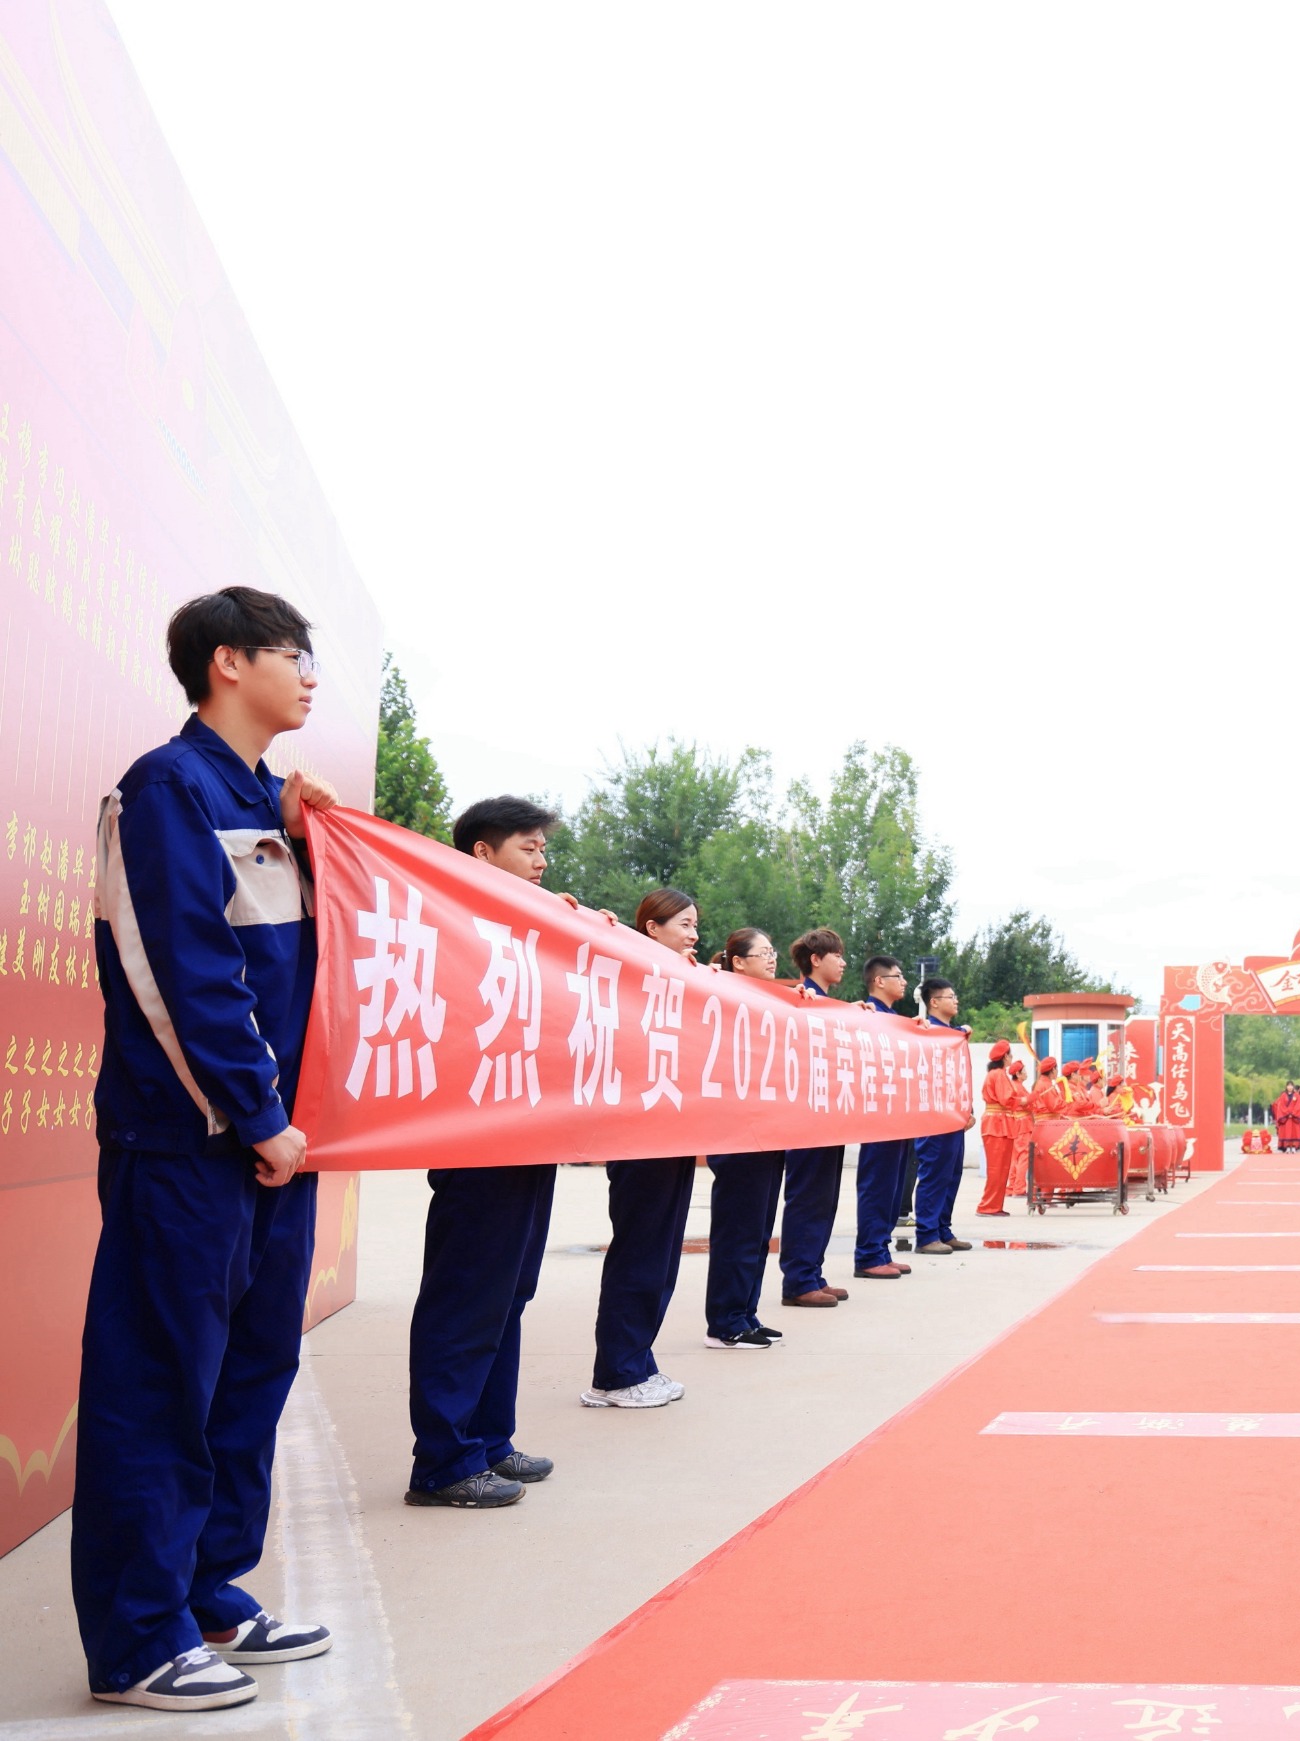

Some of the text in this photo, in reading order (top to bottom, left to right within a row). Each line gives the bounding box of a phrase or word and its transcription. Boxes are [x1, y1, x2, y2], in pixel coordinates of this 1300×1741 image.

[345, 876, 970, 1115] 热烈祝贺2026届荣程学子金榜题名
[1170, 1022, 1191, 1118] 天高任鸟飞
